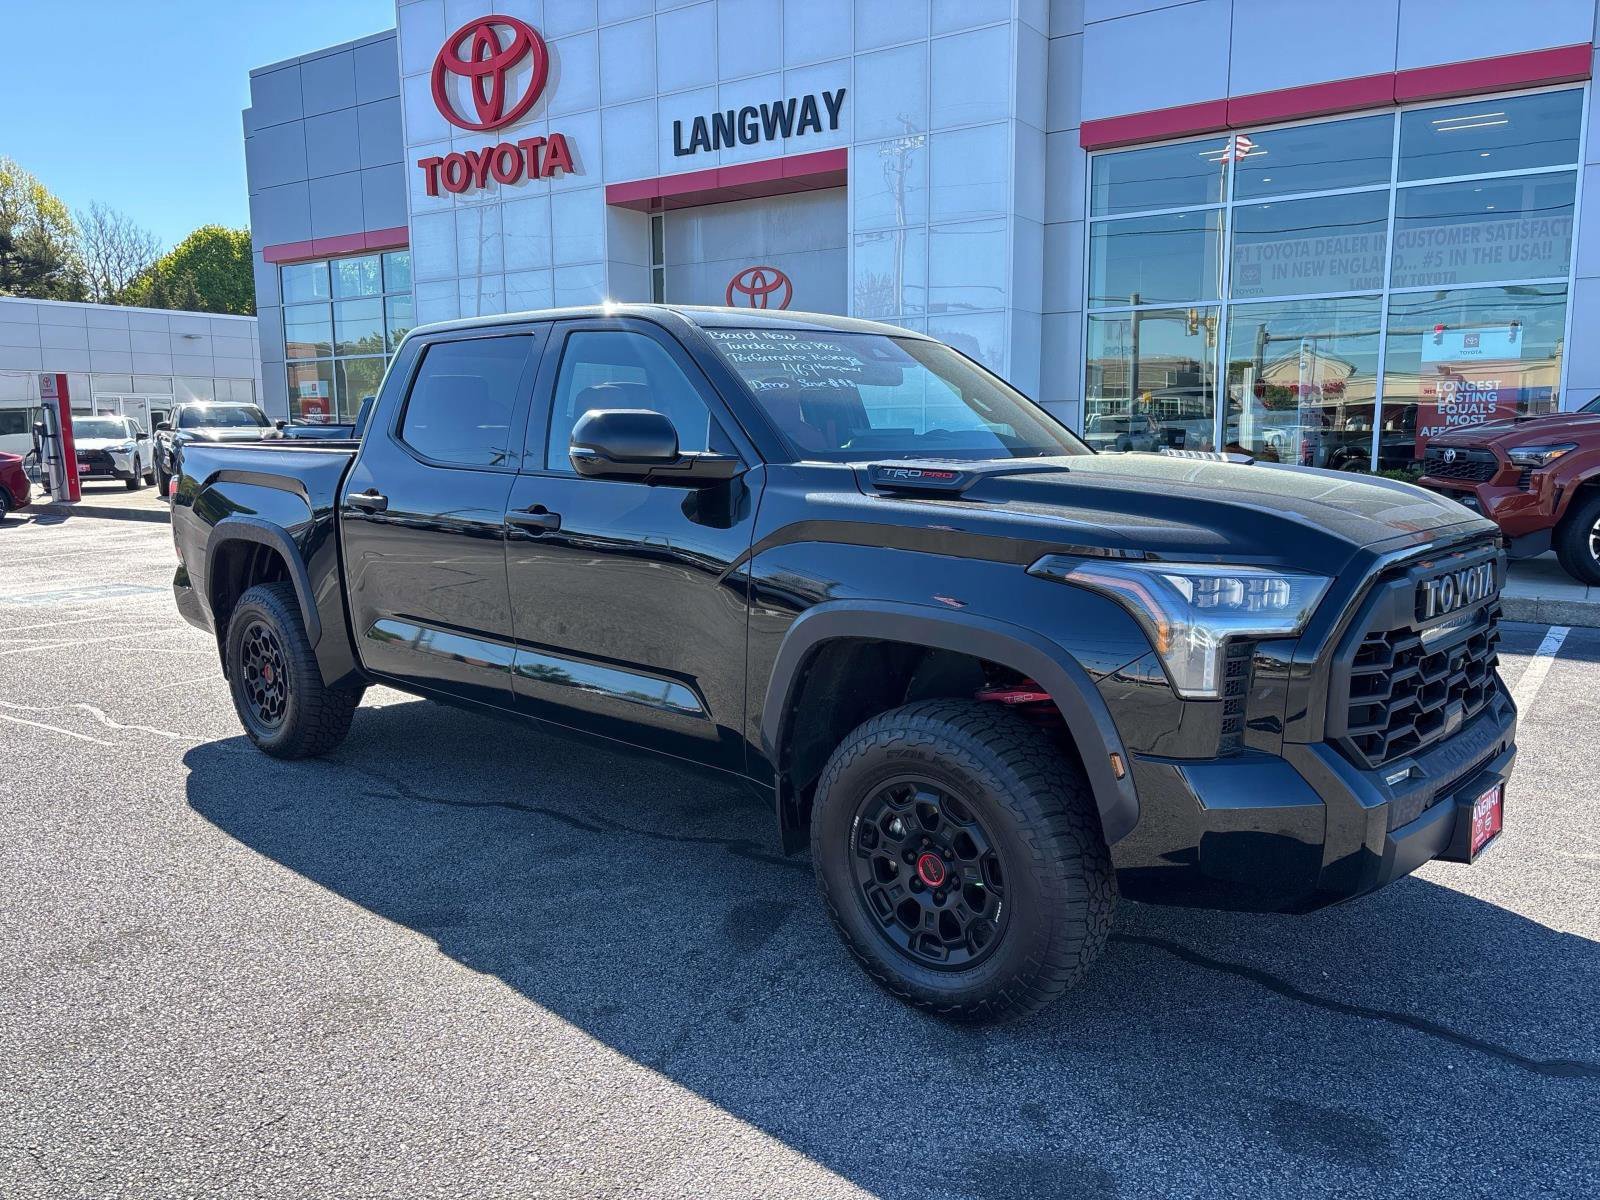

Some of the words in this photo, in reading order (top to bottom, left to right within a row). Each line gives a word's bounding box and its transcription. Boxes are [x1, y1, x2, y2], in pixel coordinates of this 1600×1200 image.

[673, 88, 847, 157] LANGWAY
[418, 133, 574, 196] TOYOTA
[1257, 241, 1310, 260] TOYOTA
[1314, 237, 1370, 256] DEALER
[1395, 227, 1480, 249] CUSTOMER
[1486, 219, 1572, 242] SATISFACT
[1272, 263, 1288, 280] IN
[1292, 260, 1326, 279] NEW
[1330, 254, 1416, 276] ENGLAD...
[1423, 252, 1443, 269] #5
[1450, 248, 1467, 266] IN
[1473, 245, 1503, 263] THE
[706, 331, 761, 341] Brand
[1436, 380, 1502, 392] LONGEST
[1438, 391, 1498, 403] LASTING
[1437, 403, 1496, 415] EQUALS
[1446, 414, 1487, 426] MOST
[883, 468, 922, 479] TRD
[922, 471, 954, 479] PRO
[1423, 561, 1494, 617] TOYOTA
